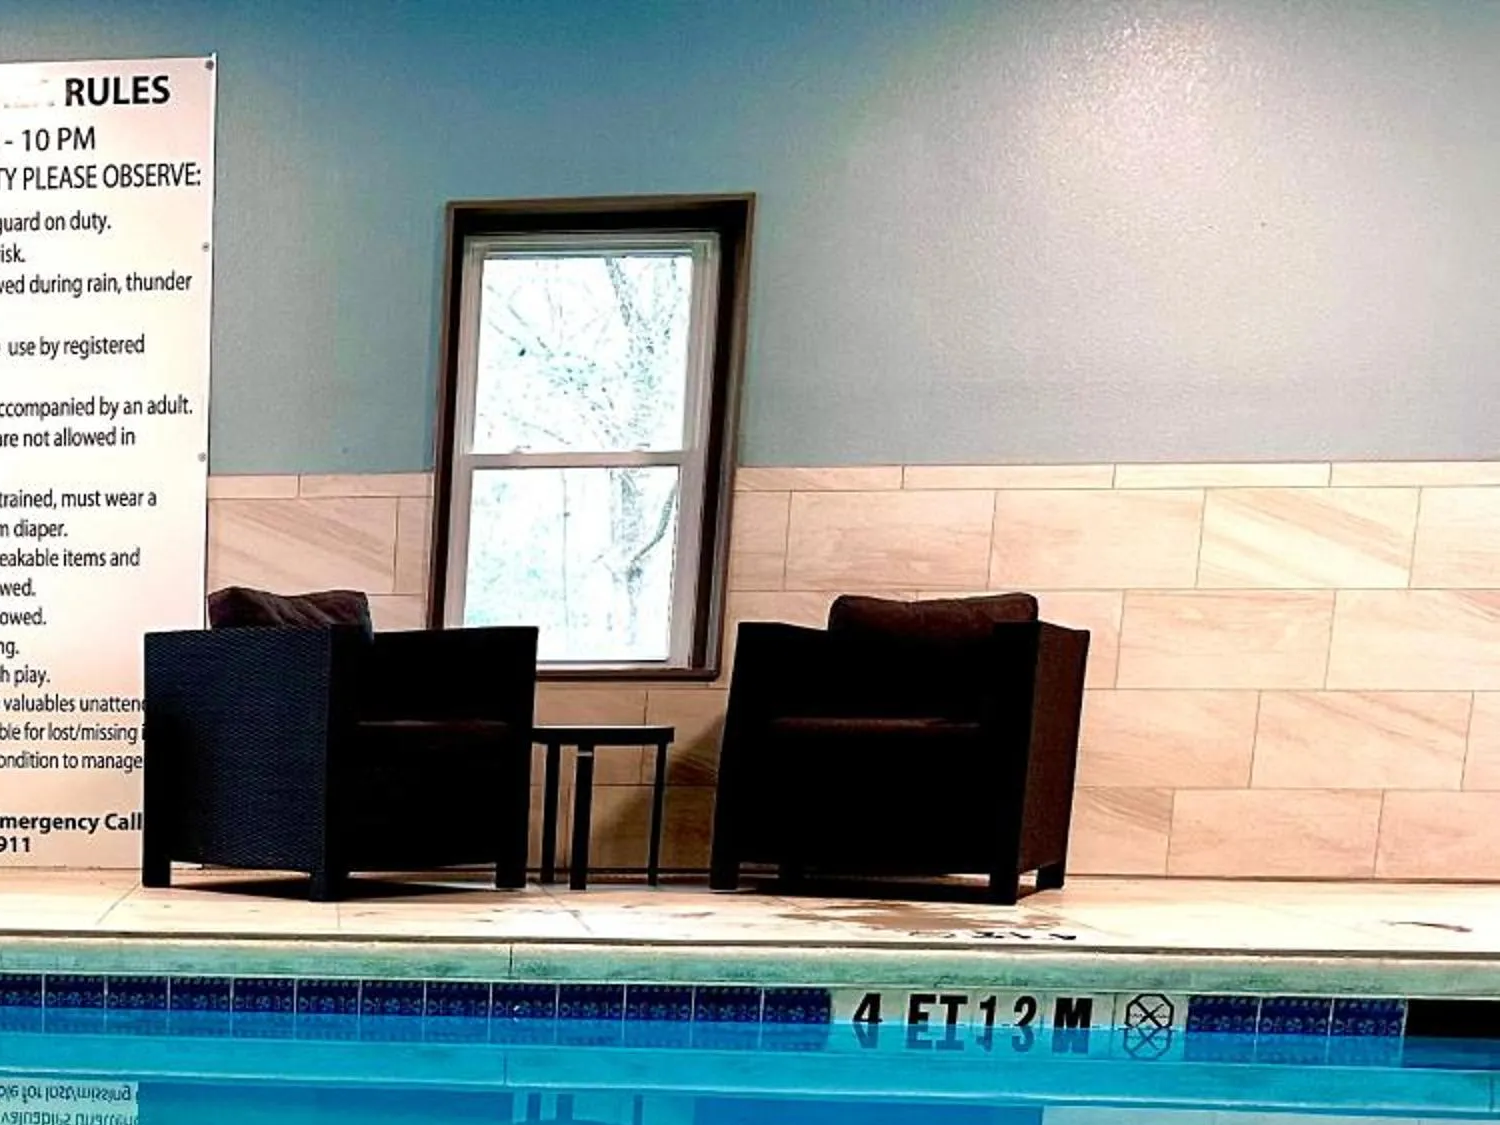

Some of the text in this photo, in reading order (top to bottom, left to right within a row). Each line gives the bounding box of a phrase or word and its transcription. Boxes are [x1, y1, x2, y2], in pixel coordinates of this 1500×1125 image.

[65, 75, 170, 107] RULES
[22, 128, 50, 152] 10
[58, 126, 95, 151] PM
[23, 164, 97, 190] PLEASE
[102, 162, 201, 188] OBSERVE:
[44, 216, 66, 231] on
[70, 210, 111, 235] duty.
[29, 274, 82, 299] during
[87, 272, 122, 294] rain,
[126, 270, 192, 292] thunder
[8, 341, 36, 356] use
[40, 336, 60, 360] by
[64, 333, 145, 360] registered
[99, 396, 119, 421] by
[123, 400, 142, 415] an
[147, 394, 192, 415] adult.
[23, 431, 50, 447] not
[54, 426, 116, 447] allowed
[121, 426, 136, 445] in
[61, 490, 101, 508] must
[105, 492, 144, 507] wear
[148, 492, 157, 506] a
[13, 519, 68, 542] diaper.
[63, 548, 106, 567] items
[110, 547, 140, 567] and
[14, 664, 50, 688] play.
[3, 693, 76, 712] valuables
[24, 721, 46, 741] for
[48, 722, 139, 746] lost/missing
[62, 753, 78, 769] to
[104, 811, 143, 831] Call
[852, 993, 883, 1034] 4
